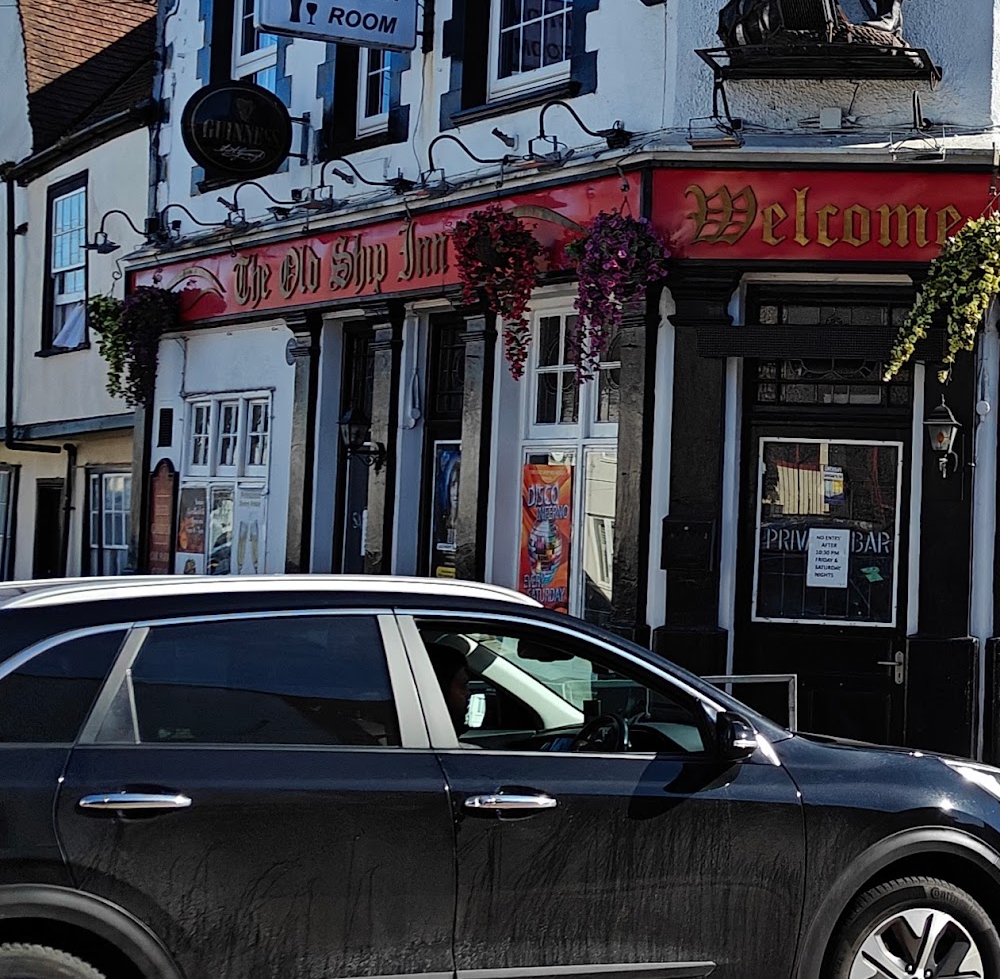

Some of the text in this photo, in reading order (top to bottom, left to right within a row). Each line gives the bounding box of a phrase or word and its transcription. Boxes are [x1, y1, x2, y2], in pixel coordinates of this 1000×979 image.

[327, 6, 398, 34] ROOM
[202, 119, 280, 146] GUINNESS
[684, 184, 963, 247] Welcome
[233, 220, 450, 310] The Old Ship Inn
[527, 483, 559, 507] DISCO
[766, 529, 890, 554] PRIV BAR
[523, 574, 545, 589] EVERY
